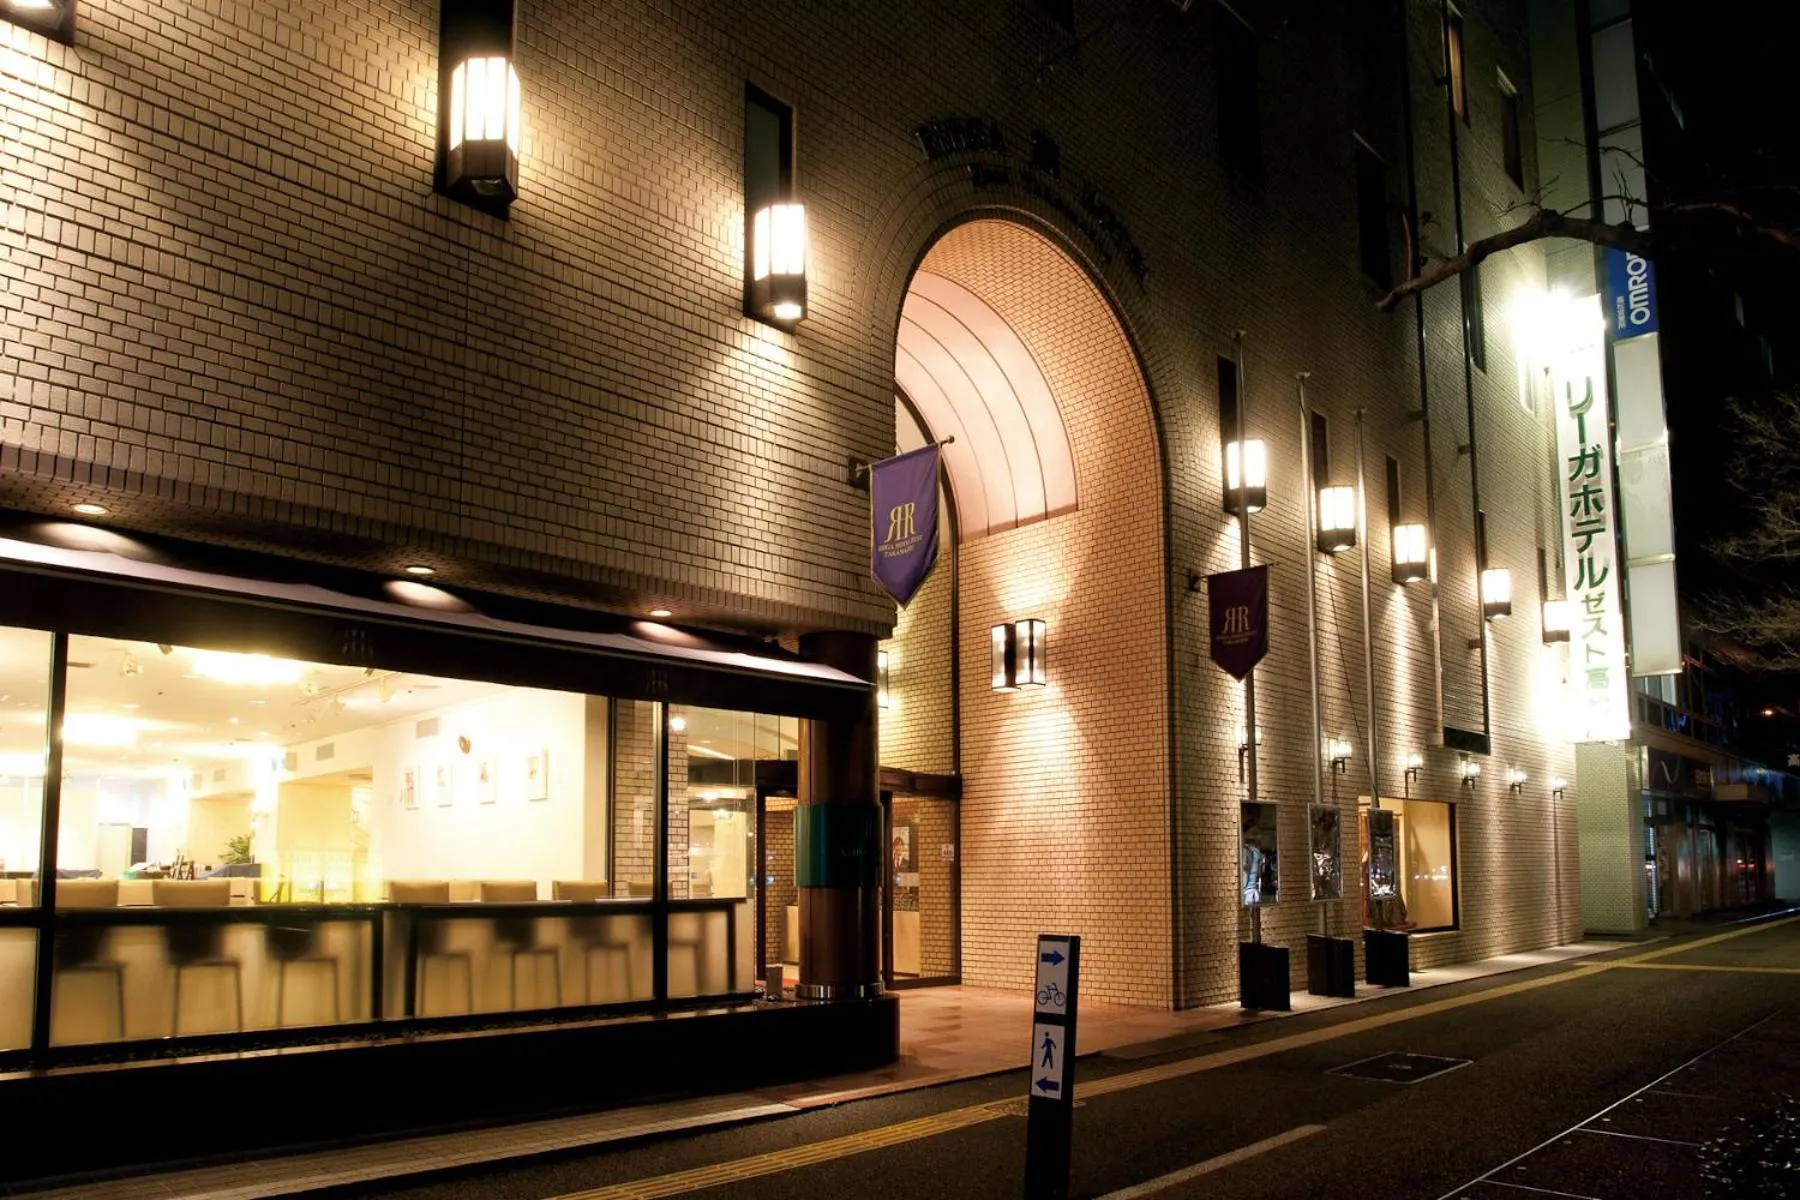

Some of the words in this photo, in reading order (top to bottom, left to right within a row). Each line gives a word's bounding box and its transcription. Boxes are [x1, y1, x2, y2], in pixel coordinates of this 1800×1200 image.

[1566, 375, 1611, 706] リーガホテルゼスト高
